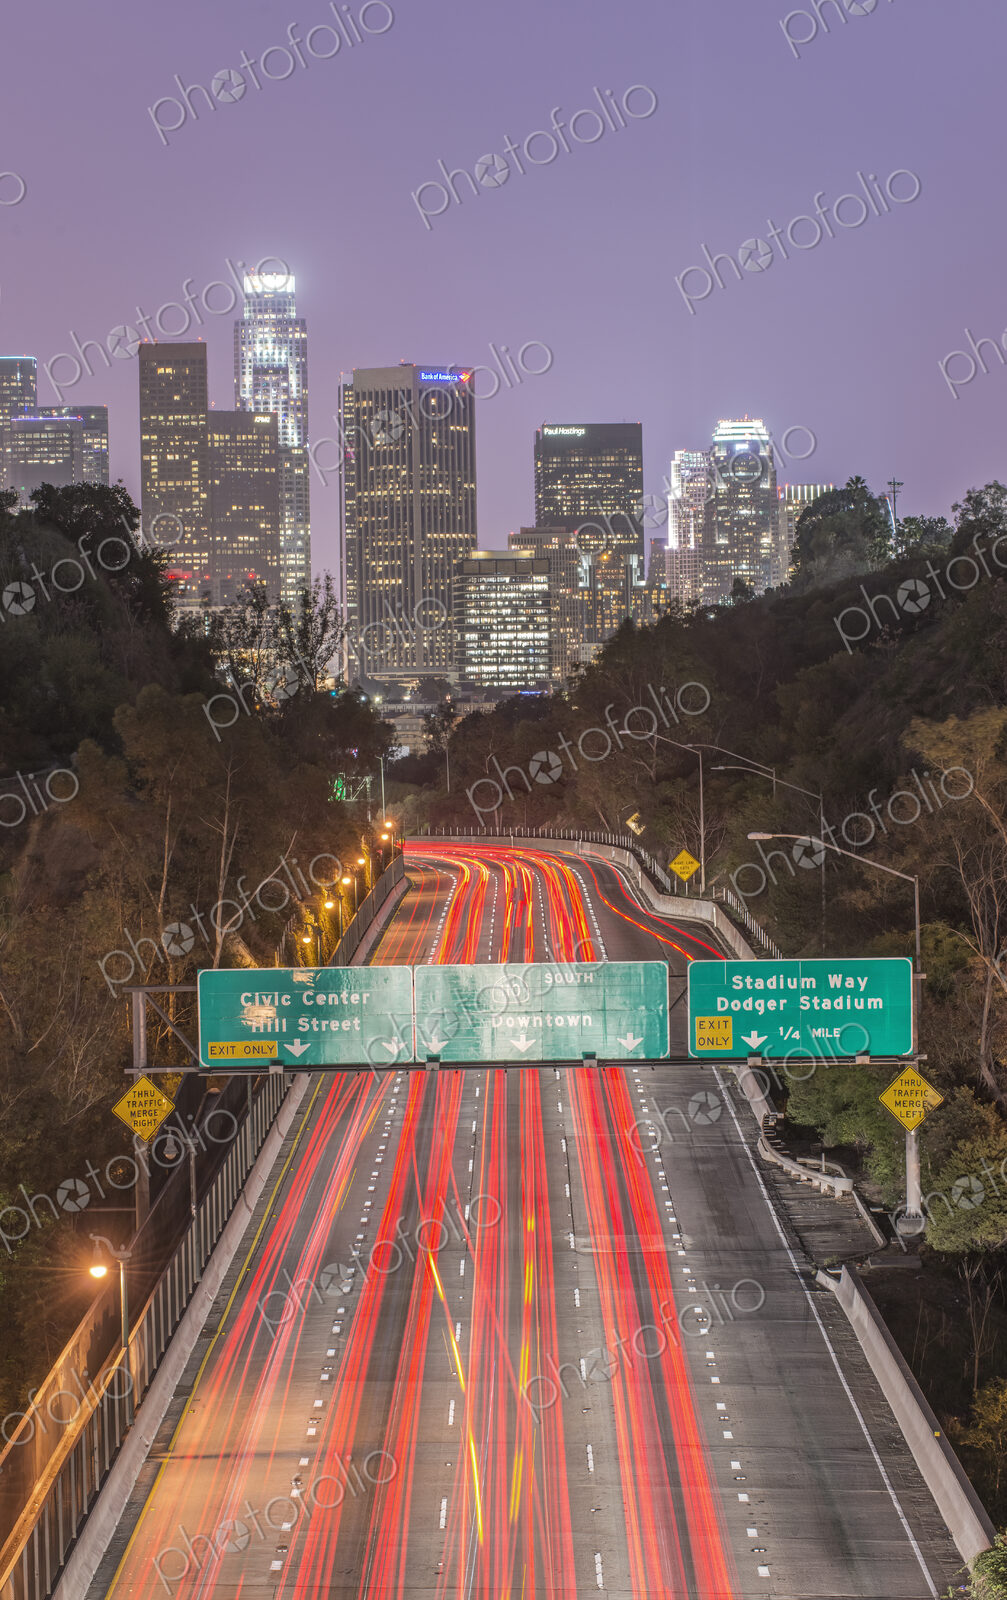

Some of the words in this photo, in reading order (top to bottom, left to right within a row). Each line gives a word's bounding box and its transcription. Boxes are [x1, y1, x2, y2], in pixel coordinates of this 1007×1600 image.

[421, 372, 434, 380] Bank
[544, 427, 558, 435] Paul
[559, 426, 585, 436] Hastings
[545, 972, 593, 983] SOUTH
[732, 974, 816, 990] Stadium
[828, 973, 868, 992] Way
[240, 991, 291, 1007] Civic
[302, 990, 370, 1006] Center
[716, 996, 787, 1015] Dodger
[800, 995, 883, 1011] Stadium
[251, 1017, 286, 1032] Hill
[298, 1016, 361, 1032] Street
[491, 1012, 592, 1028] Downtown
[698, 1020, 729, 1030] EXIT
[812, 1027, 841, 1038] MILE
[698, 1036, 730, 1046] ONLY
[210, 1045, 237, 1055] EXIT
[243, 1045, 275, 1055] ONLY
[900, 1079, 922, 1087] THRU
[133, 1090, 155, 1098] THRU
[893, 1089, 929, 1098] TRAFFIC
[127, 1099, 162, 1108] TRAFFIC
[895, 1100, 928, 1108] MERGE
[130, 1109, 158, 1118] MERGE
[133, 1119, 157, 1127] RIGHT
